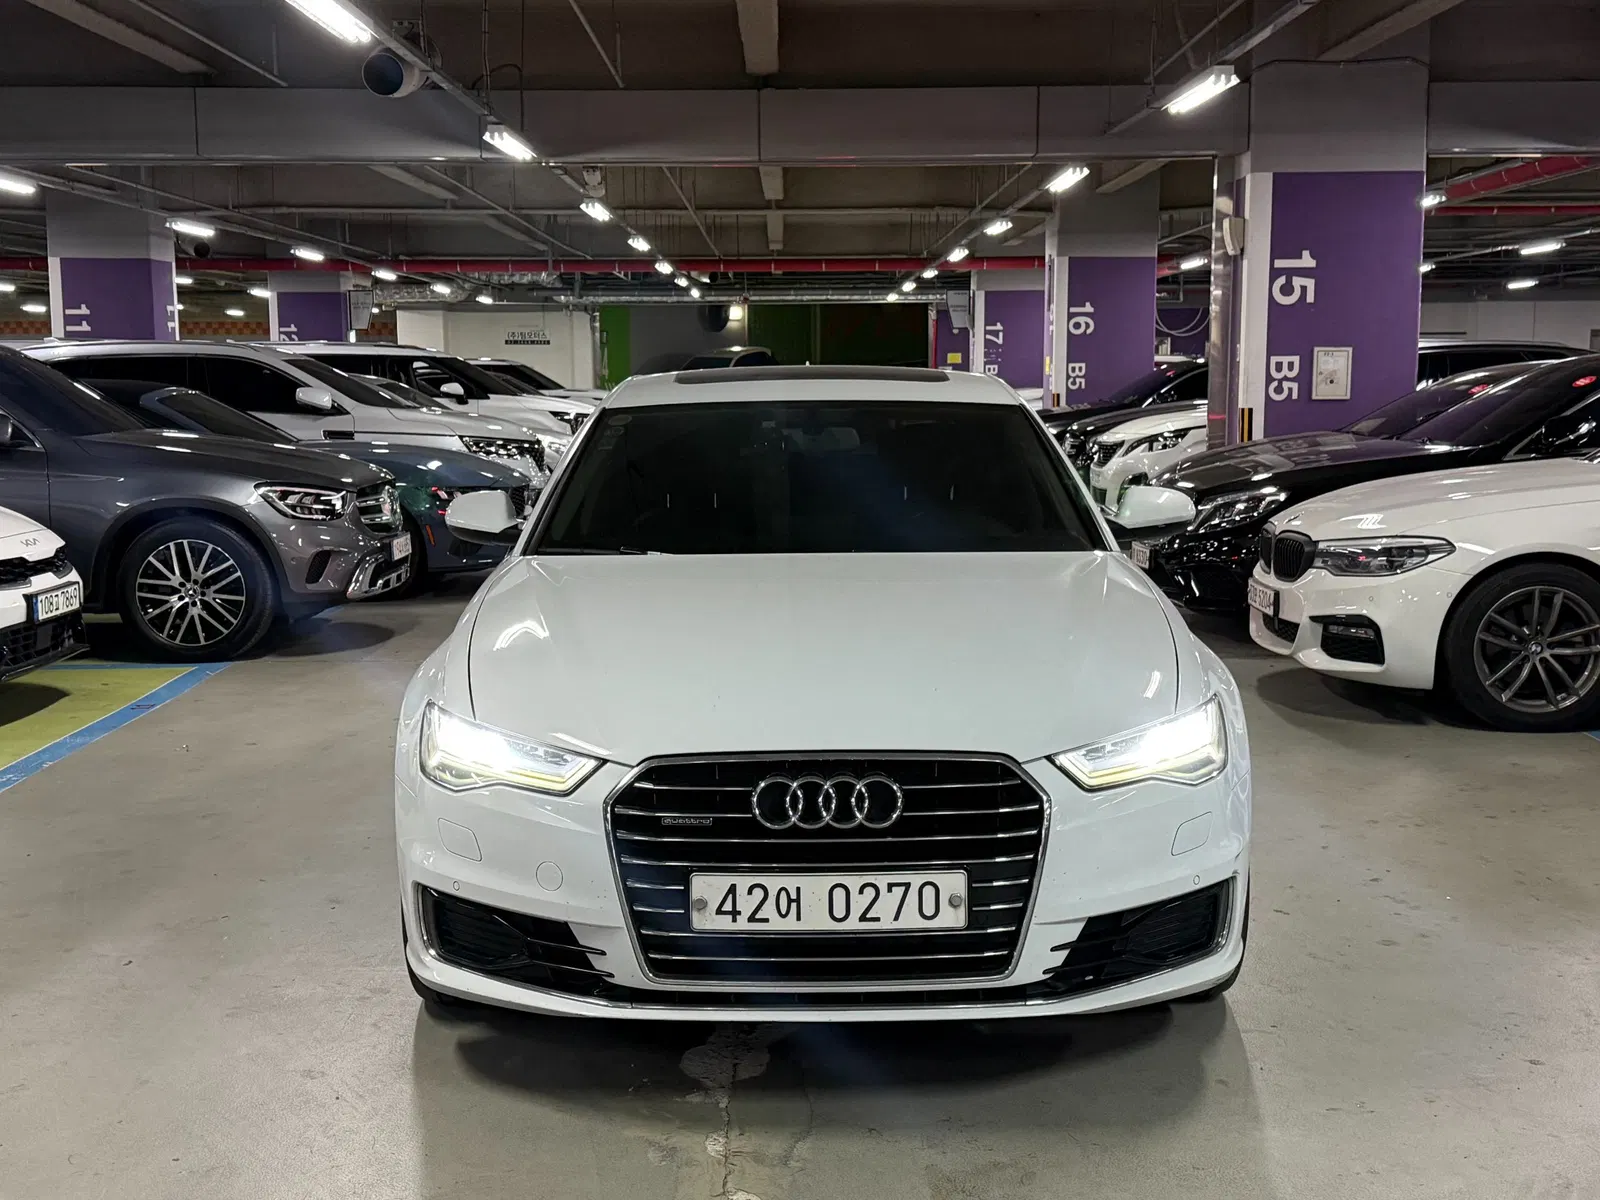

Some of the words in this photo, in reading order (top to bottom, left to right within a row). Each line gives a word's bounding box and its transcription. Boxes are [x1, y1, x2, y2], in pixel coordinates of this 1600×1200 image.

[1272, 250, 1317, 306] 15
[65, 304, 92, 332] 11
[985, 321, 1004, 345] 17
[1068, 302, 1095, 336] 16
[1067, 362, 1086, 390] B5
[1268, 355, 1300, 401] B5
[60, 587, 78, 610] 7869
[715, 883, 802, 923] 42어
[828, 881, 941, 923] 0270
